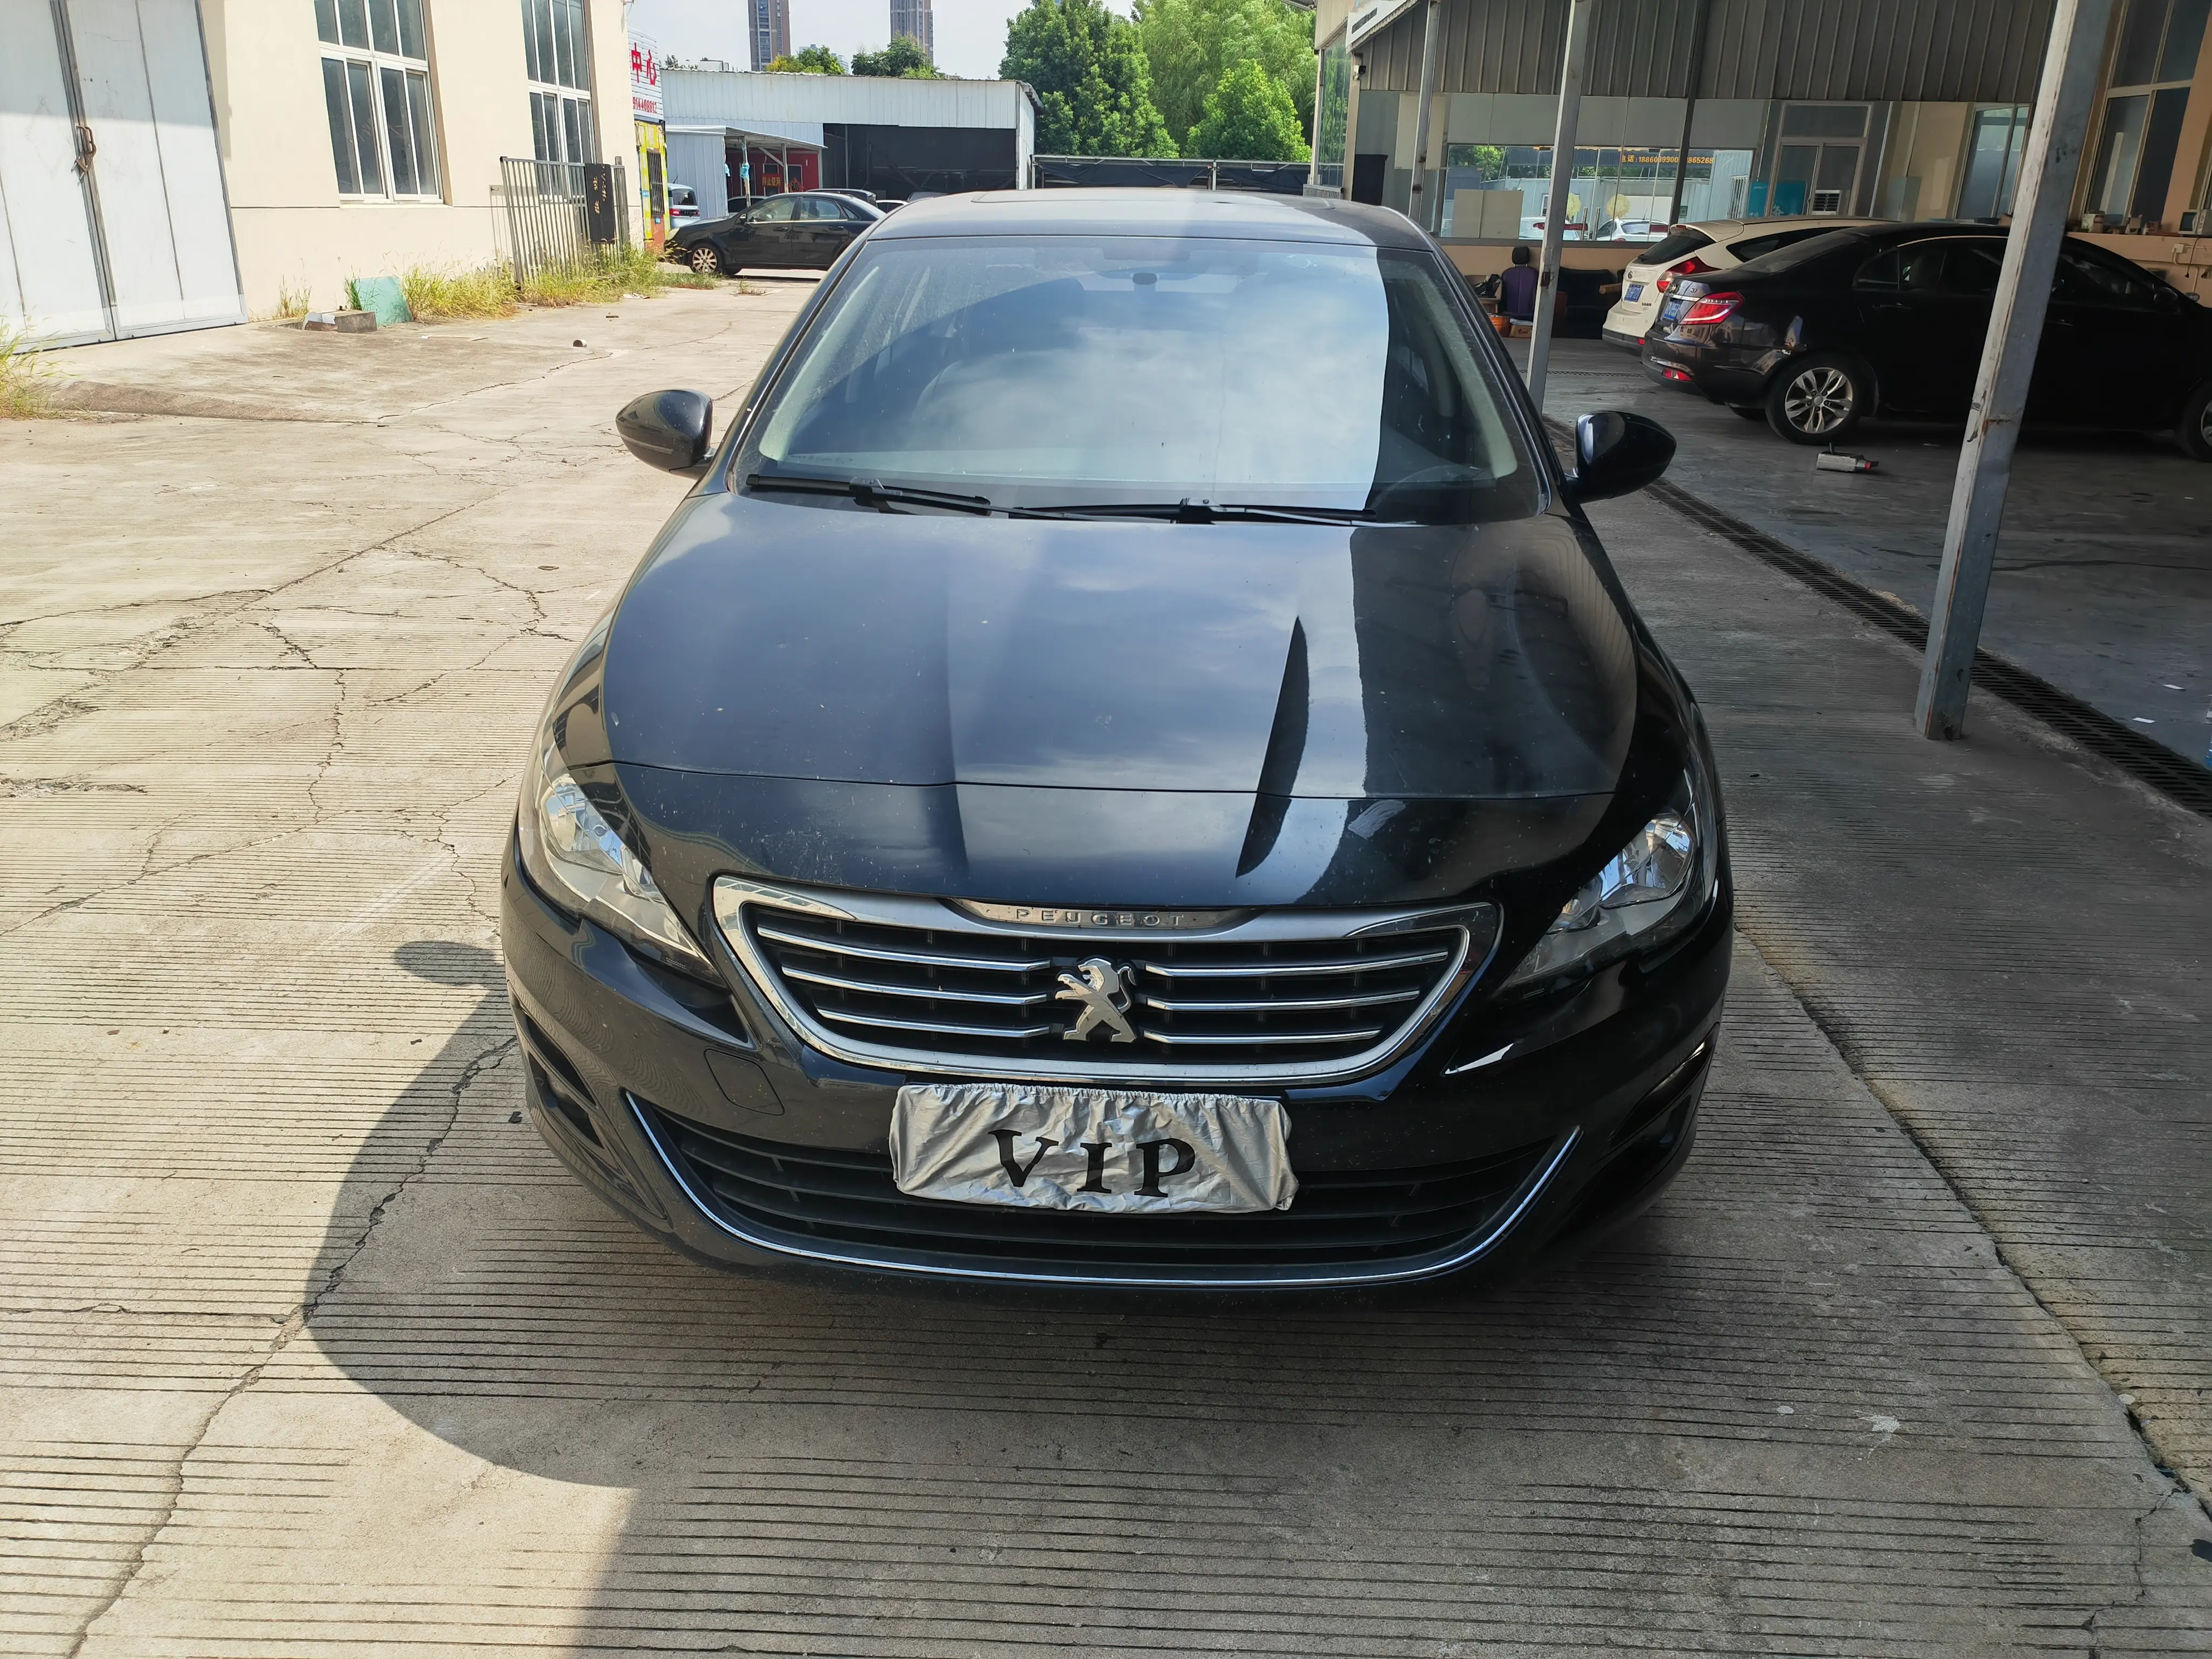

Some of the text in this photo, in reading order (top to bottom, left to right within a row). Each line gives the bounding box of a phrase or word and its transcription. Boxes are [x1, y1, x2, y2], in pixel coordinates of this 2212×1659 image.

[631, 42, 657, 86] 中心
[762, 177, 781, 186] 停止使用
[1016, 908, 1184, 927] PEUGEOT
[988, 1129, 1196, 1198] VIP
